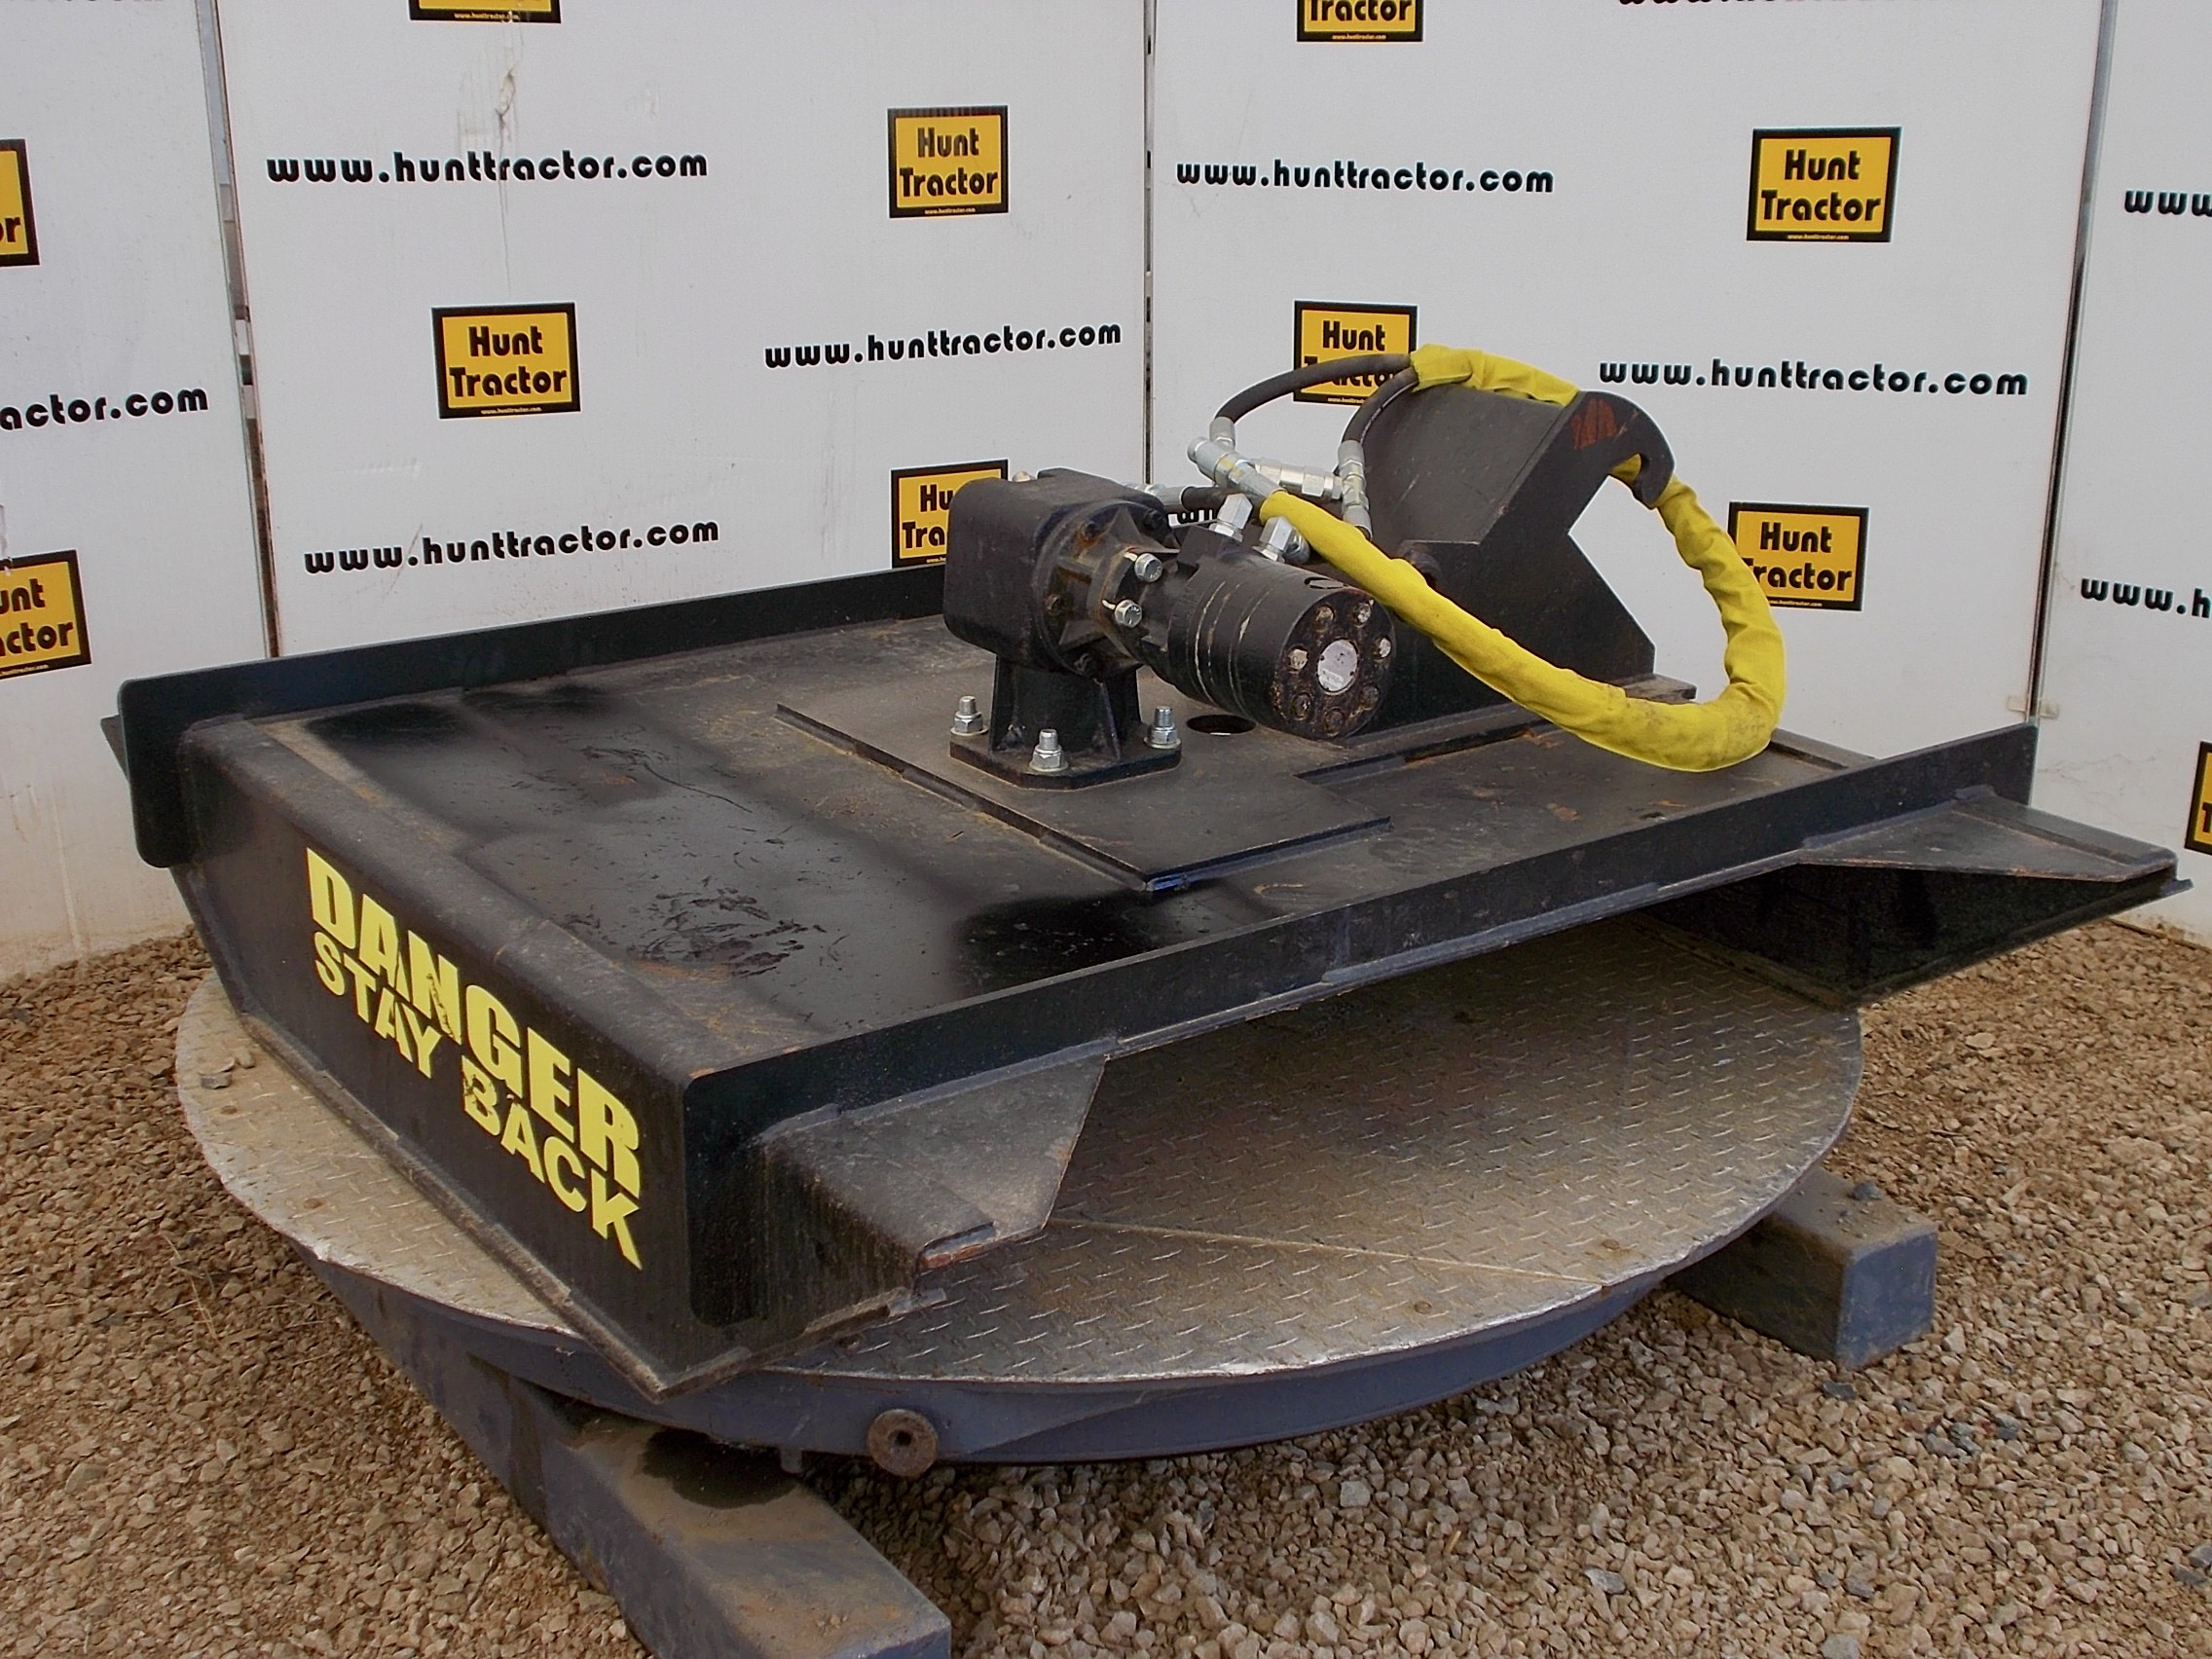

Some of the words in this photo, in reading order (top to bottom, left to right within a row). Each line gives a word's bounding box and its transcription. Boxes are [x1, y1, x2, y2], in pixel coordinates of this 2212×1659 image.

[1309, 0, 1413, 21] Tractor
[917, 127, 979, 158] Hunt
[266, 150, 708, 183] www.hunttractor.com
[1176, 159, 1554, 193] www.hunttractor.com
[1784, 149, 1861, 181] Hunt
[899, 166, 998, 198] Tractor
[1760, 189, 1881, 221] Tractor
[468, 325, 543, 357] Hunt
[764, 324, 1122, 369] www.hunttractor.com
[1322, 319, 1385, 351] Hunt
[449, 365, 567, 397] Tractor
[1599, 358, 2028, 396] www.hunttractor.com
[919, 484, 954, 512] Hu
[304, 521, 719, 574] www.hunttractor.com
[1759, 521, 1832, 553] Hunt
[307, 848, 641, 1199] DANGER
[313, 931, 441, 1079] STAY
[461, 1054, 642, 1270] BACK
